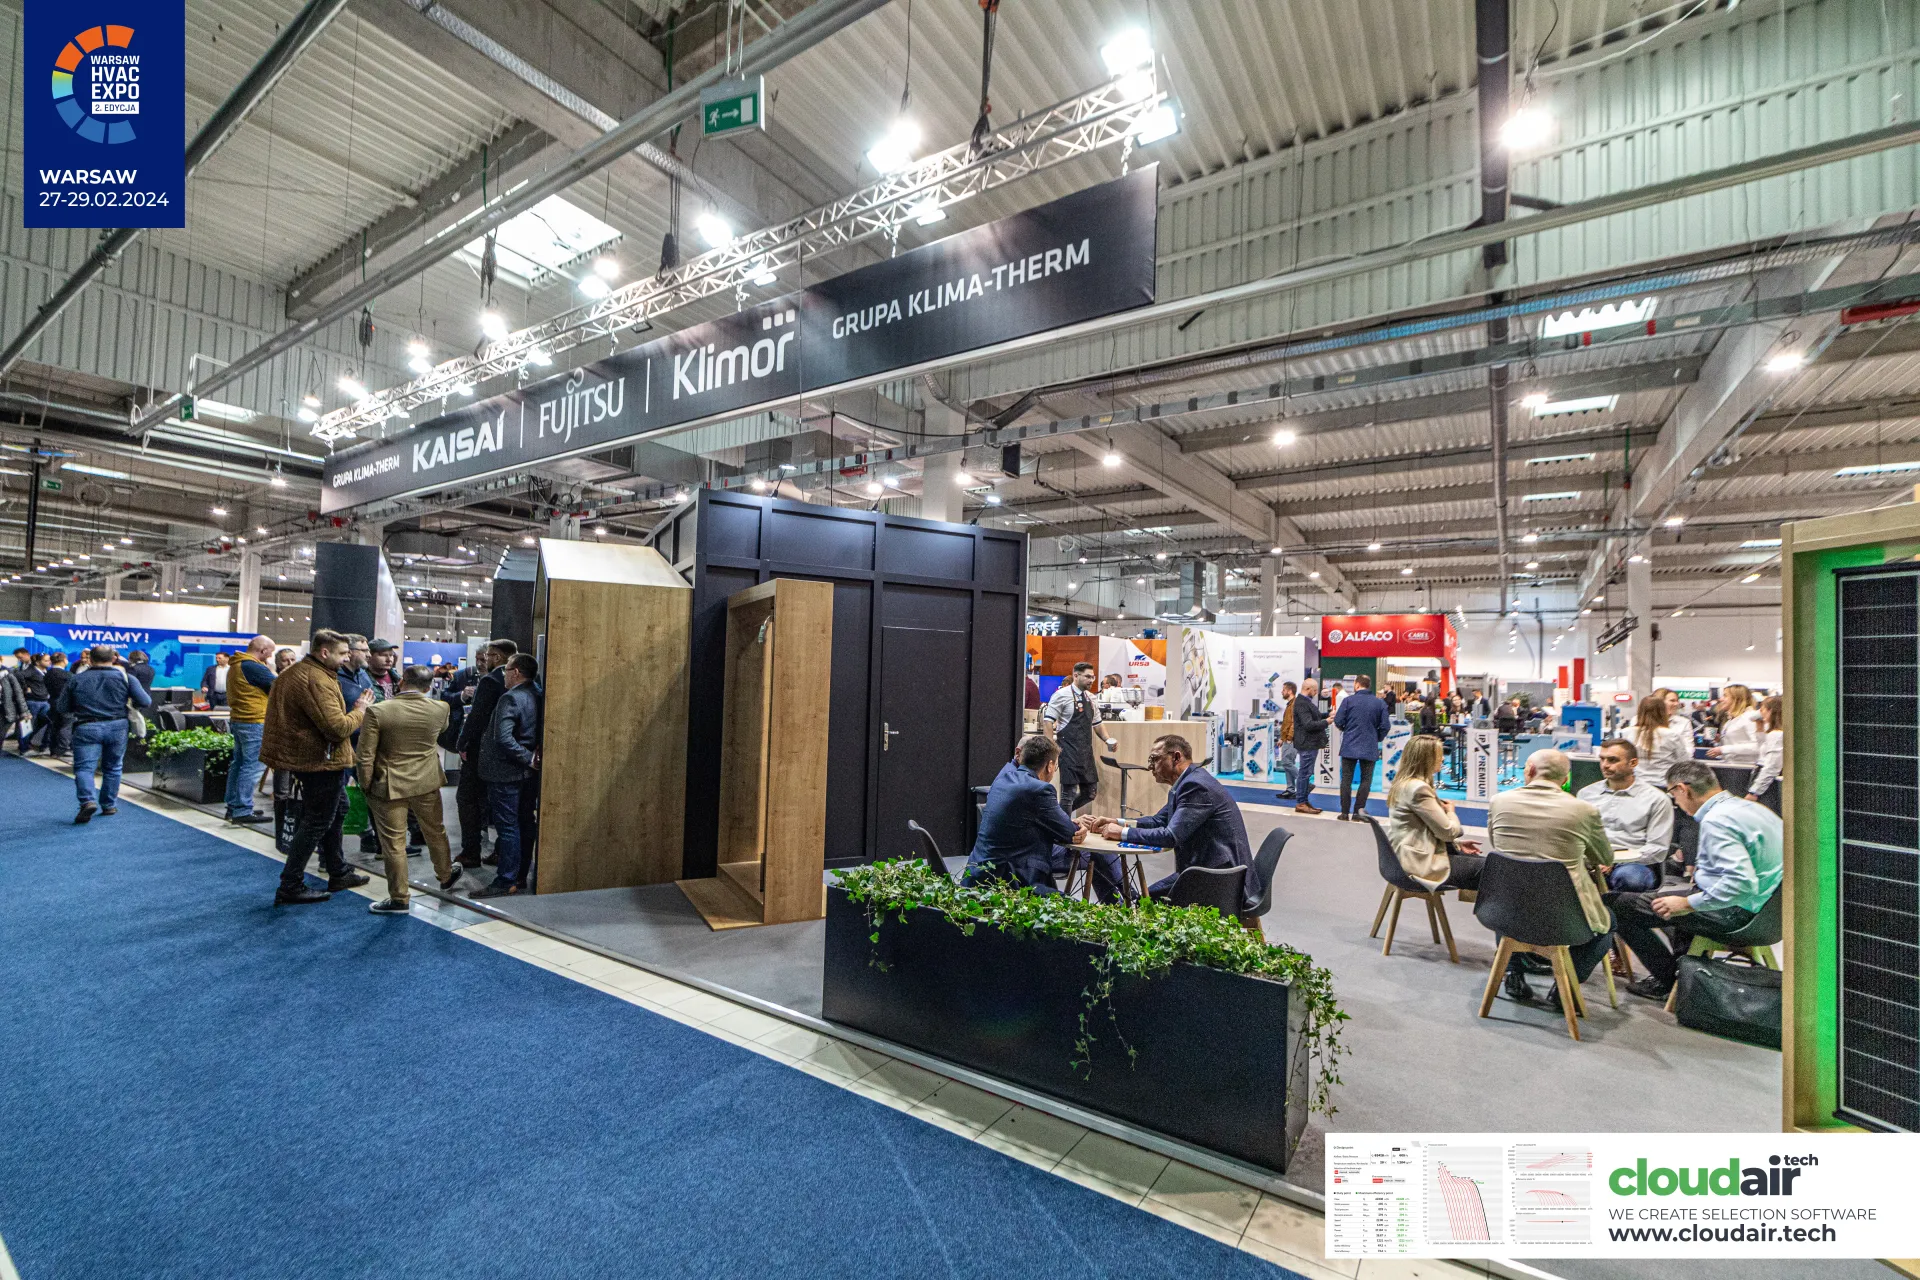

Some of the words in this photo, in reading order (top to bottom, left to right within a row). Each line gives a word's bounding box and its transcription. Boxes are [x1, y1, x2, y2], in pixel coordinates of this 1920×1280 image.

[832, 300, 902, 340] GRUPA
[908, 238, 1091, 317] KLIMA-THERM
[673, 331, 795, 400] Klimor
[538, 376, 626, 444] FUJITSU
[412, 410, 505, 473] KAISAI
[332, 470, 353, 488] GRUPA
[353, 454, 400, 482] KLIMA-THERM
[68, 629, 142, 643] WITAMY
[1344, 631, 1393, 641] ALFACO
[1478, 755, 1486, 797] PREMIUM
